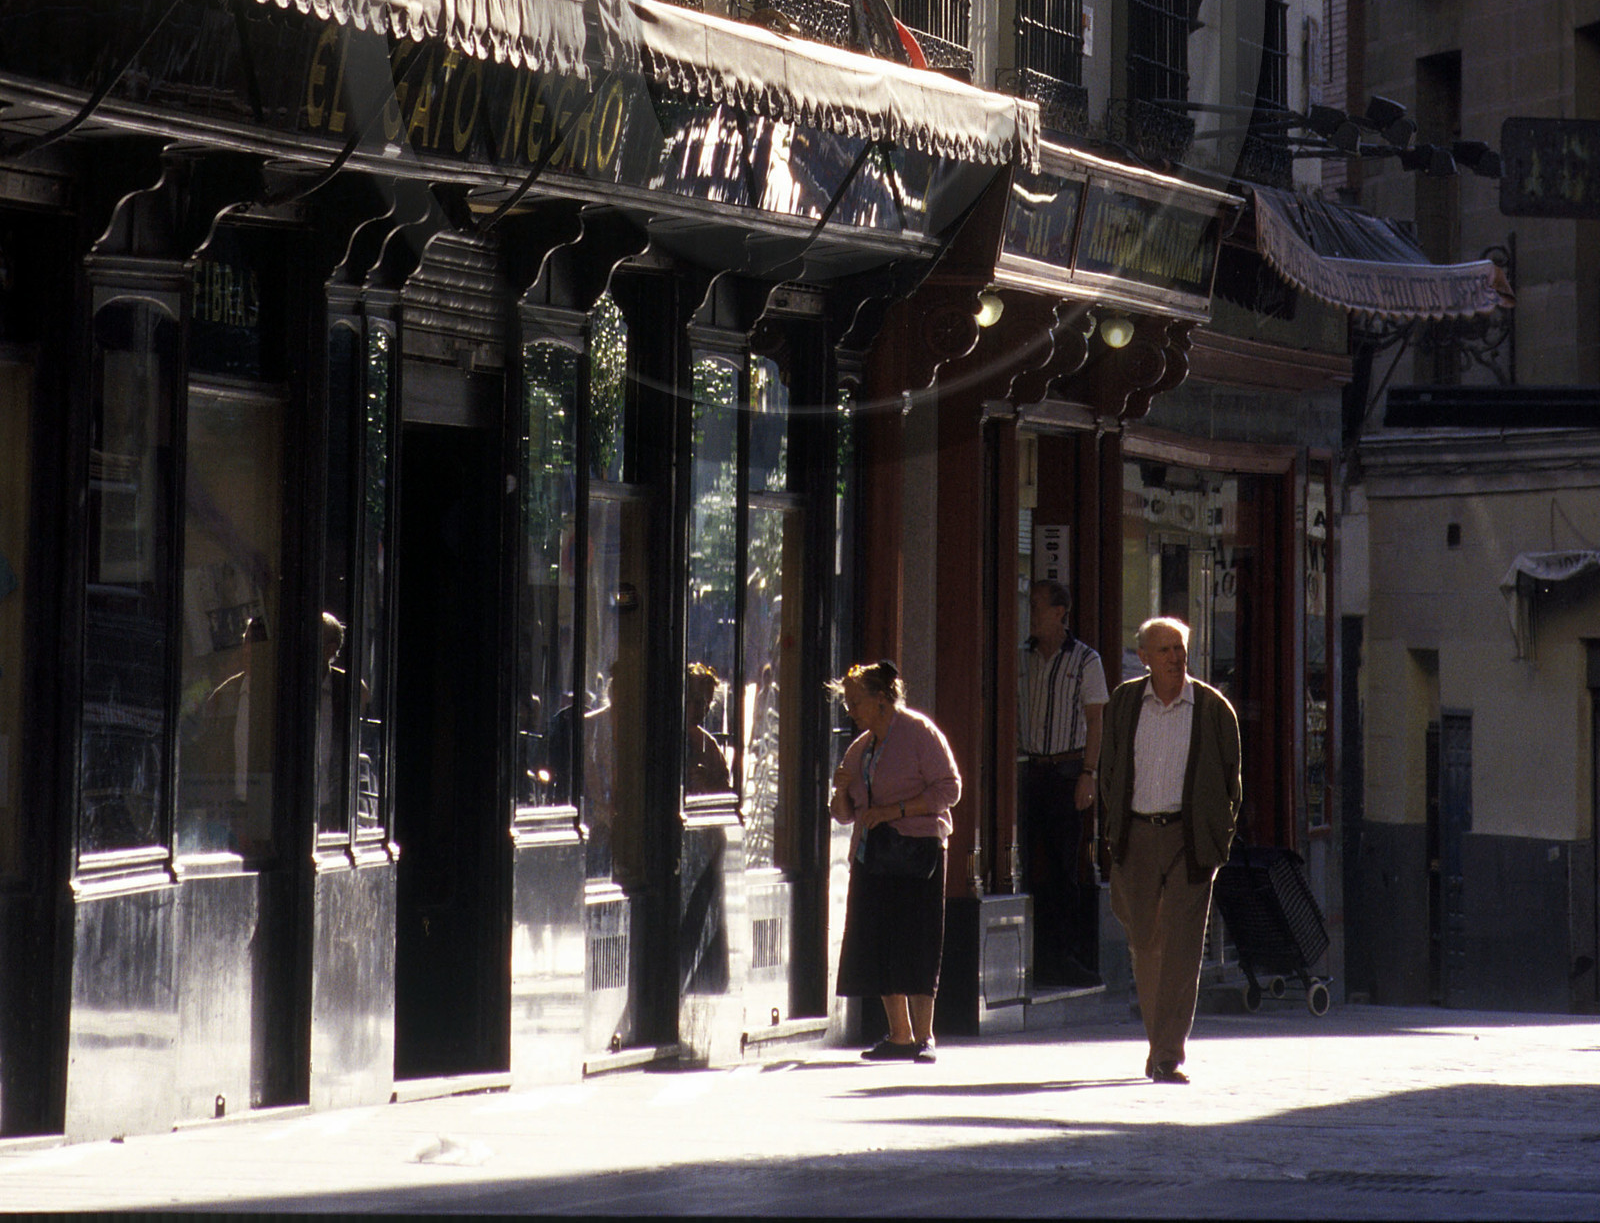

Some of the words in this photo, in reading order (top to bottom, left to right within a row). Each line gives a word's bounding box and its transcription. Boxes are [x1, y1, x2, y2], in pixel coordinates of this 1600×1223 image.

[306, 27, 351, 133] EL
[383, 39, 484, 154] GATO
[501, 65, 625, 172] NEGRO
